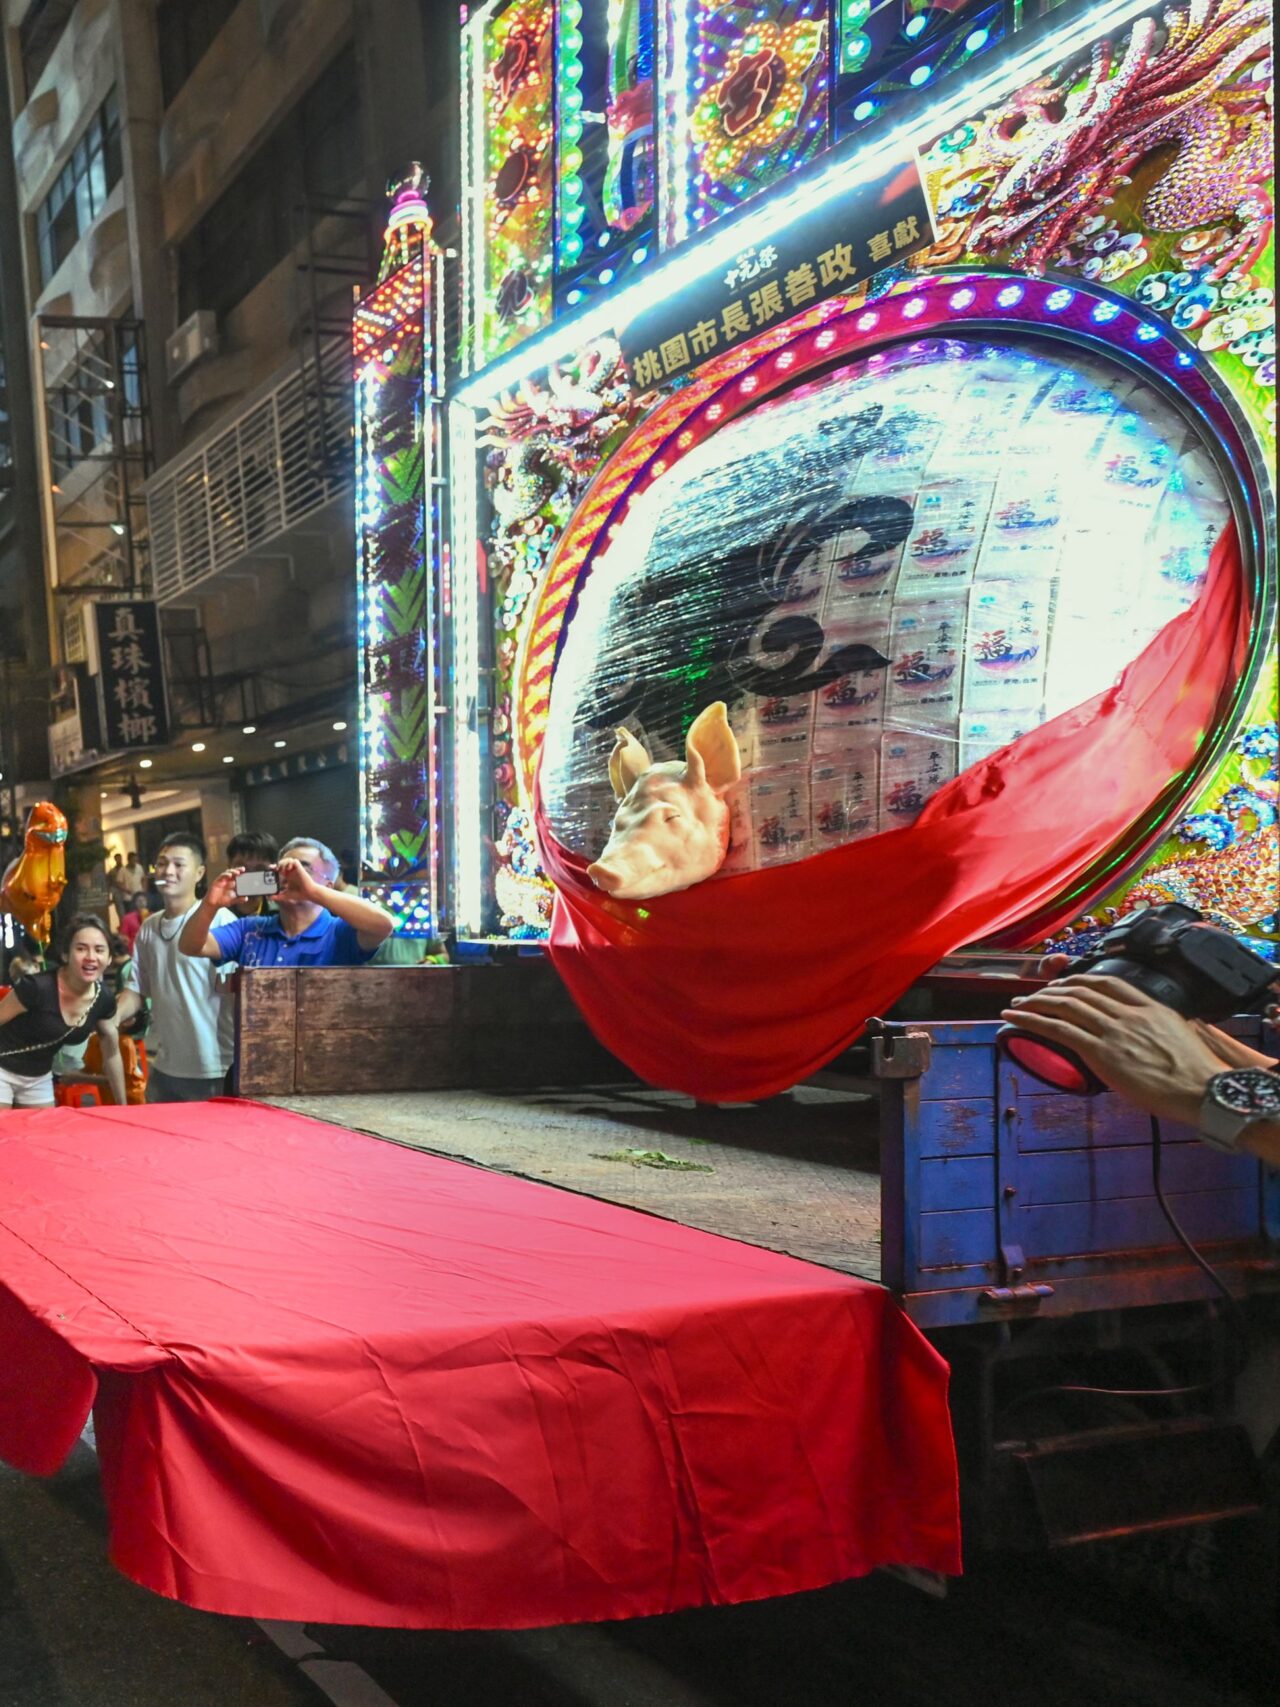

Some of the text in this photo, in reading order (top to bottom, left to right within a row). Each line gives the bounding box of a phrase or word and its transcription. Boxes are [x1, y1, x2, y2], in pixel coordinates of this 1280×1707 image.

[632, 216, 920, 389] 桃園市長張善政 喜獻
[108, 607, 157, 744] 真珠檳榔
